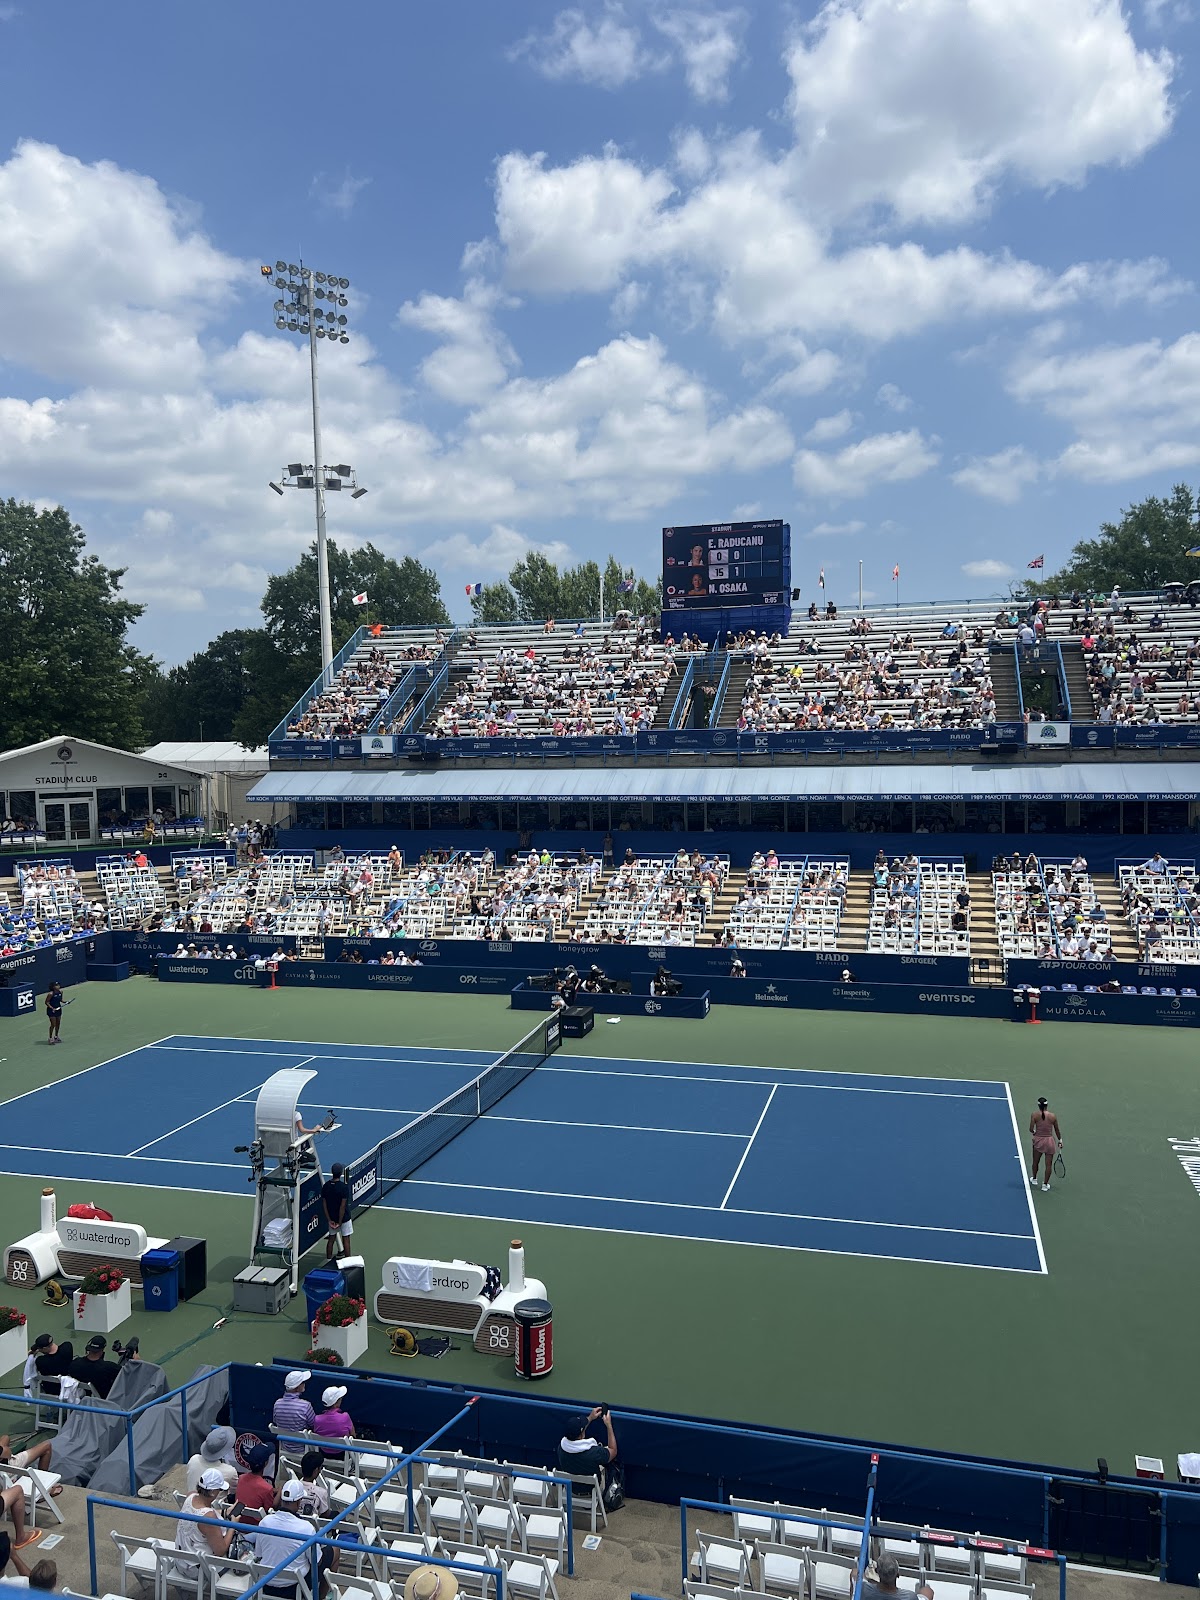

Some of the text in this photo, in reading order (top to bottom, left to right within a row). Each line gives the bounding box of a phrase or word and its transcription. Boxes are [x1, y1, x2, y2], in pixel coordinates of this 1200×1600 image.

[708, 536, 764, 548] E. RADUCANU
[717, 550, 740, 561] 0 0
[715, 566, 739, 577] 15 1
[708, 582, 748, 594] N. OSAKA
[764, 596, 778, 604] 0:05
[755, 738, 768, 746] DC
[35, 775, 98, 784] STADIUM CLUB
[193, 934, 217, 942] Insperity
[248, 935, 284, 944] WTATENNIS.COM
[343, 938, 372, 946] SEATGEEK
[558, 944, 600, 954] honeygrow
[27, 955, 36, 964] DC
[648, 951, 667, 959] ONE
[815, 953, 849, 962] RADO
[900, 956, 938, 966] SEATGEEK
[169, 965, 209, 975] waterdrop
[234, 965, 256, 979] citi
[1150, 965, 1177, 973] TENNIS
[459, 975, 478, 984] OFX
[755, 993, 789, 1002] Heineken
[841, 988, 871, 998] Insperity
[18, 993, 33, 1007] DC
[918, 993, 976, 1004] events DC
[1046, 1007, 1107, 1016] MUBADALA
[352, 1167, 377, 1195] HOLOGIC
[307, 1216, 319, 1233] citi
[79, 1231, 131, 1247] waterdrop
[535, 1327, 547, 1372] Wilson
